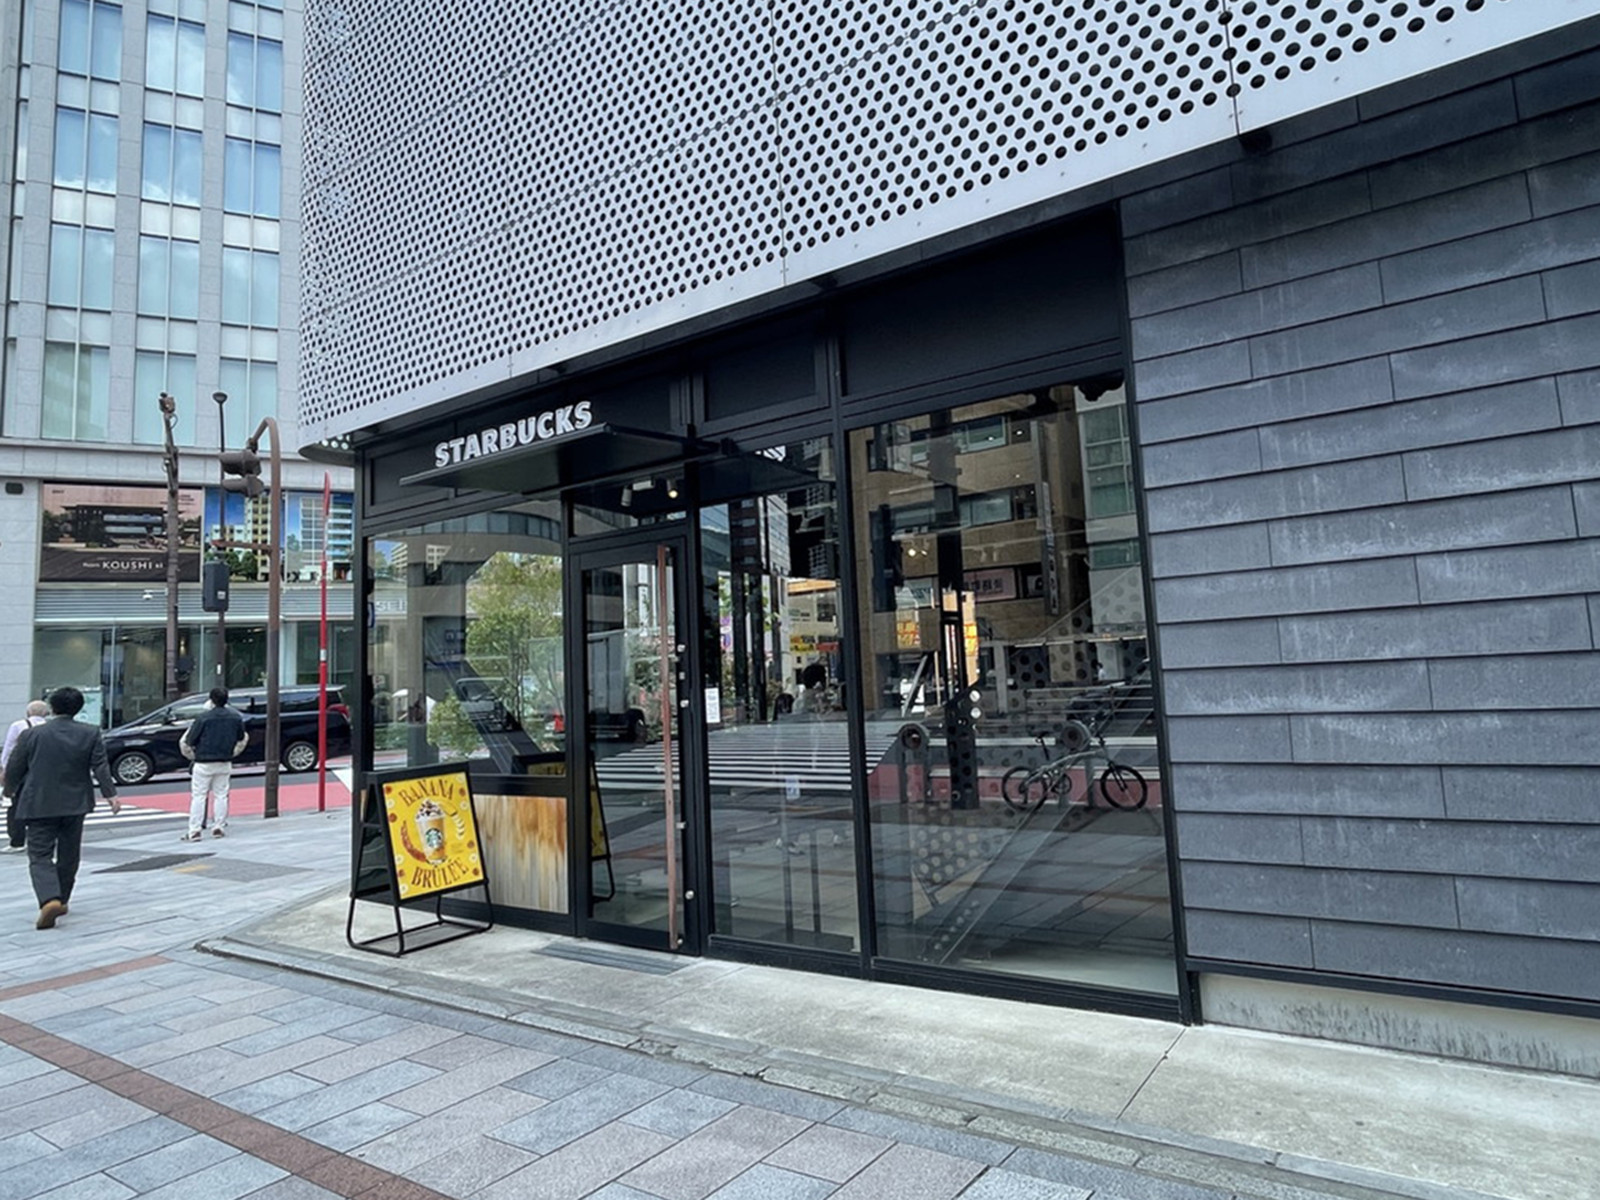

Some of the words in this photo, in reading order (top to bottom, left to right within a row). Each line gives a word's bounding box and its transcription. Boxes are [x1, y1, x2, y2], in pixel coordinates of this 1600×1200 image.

[434, 400, 593, 468] STARBUCKS
[102, 561, 153, 570] KOUSHI
[398, 779, 455, 807] BANANA
